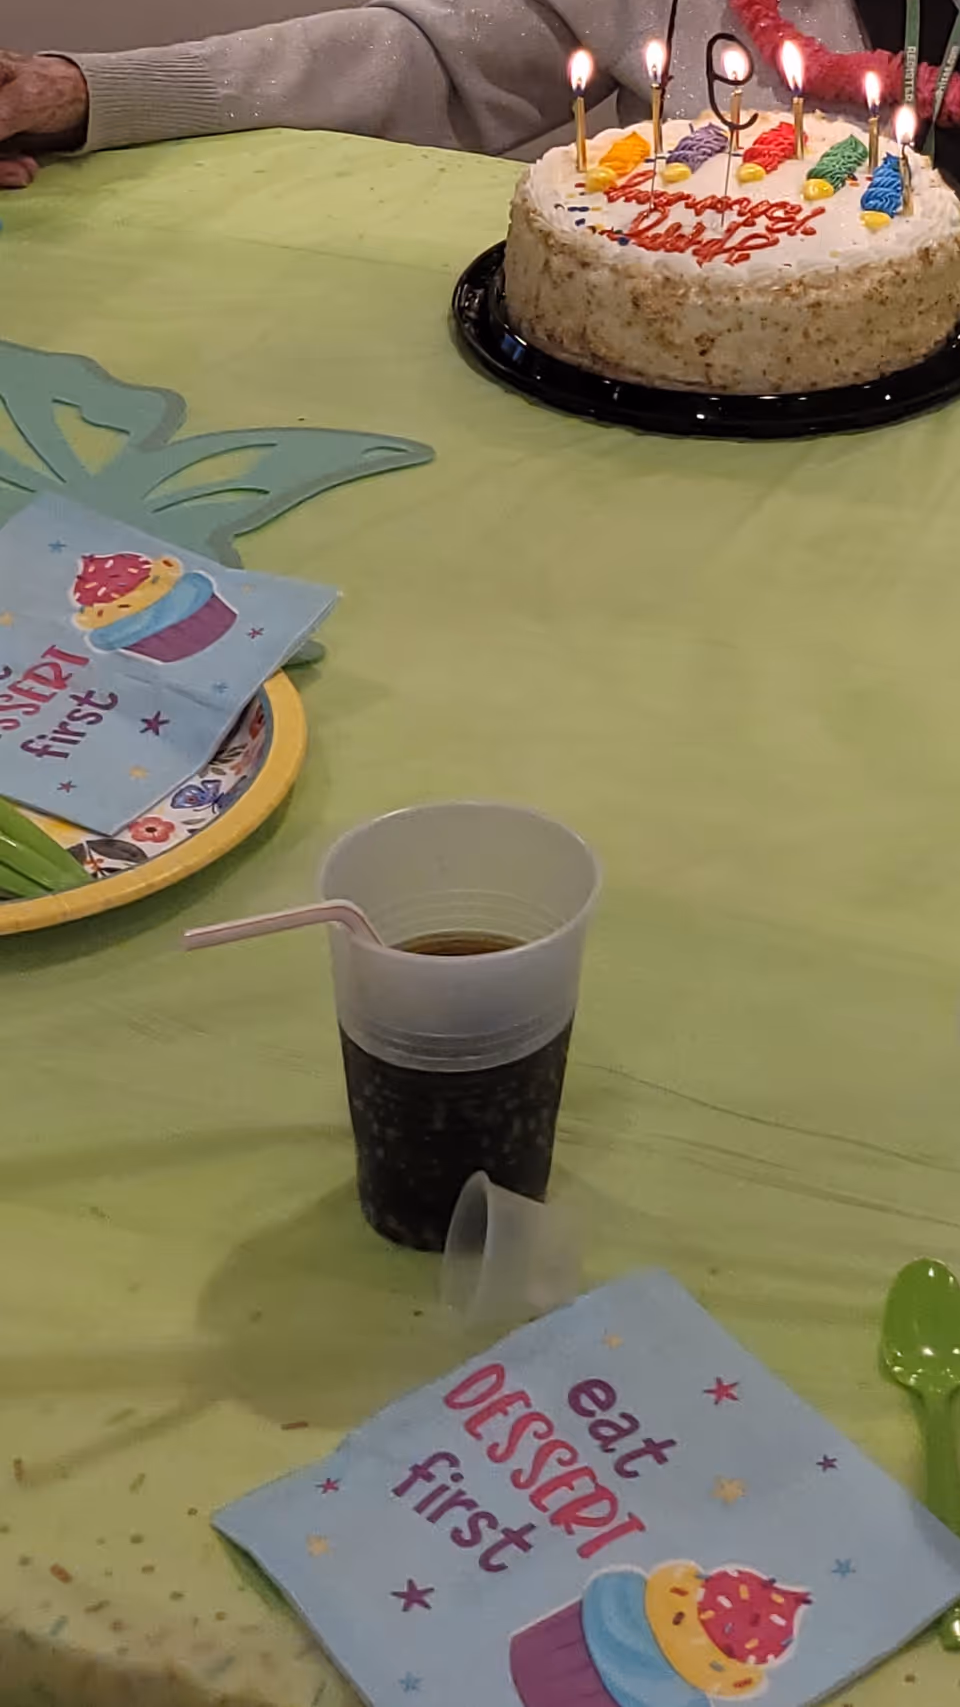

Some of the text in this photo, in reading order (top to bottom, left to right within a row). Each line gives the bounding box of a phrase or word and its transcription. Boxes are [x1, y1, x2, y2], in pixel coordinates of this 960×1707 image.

[20, 690, 118, 759] first
[442, 1362, 646, 1560] DESSERT
[567, 1377, 677, 1479] eat
[391, 1451, 538, 1573] first
